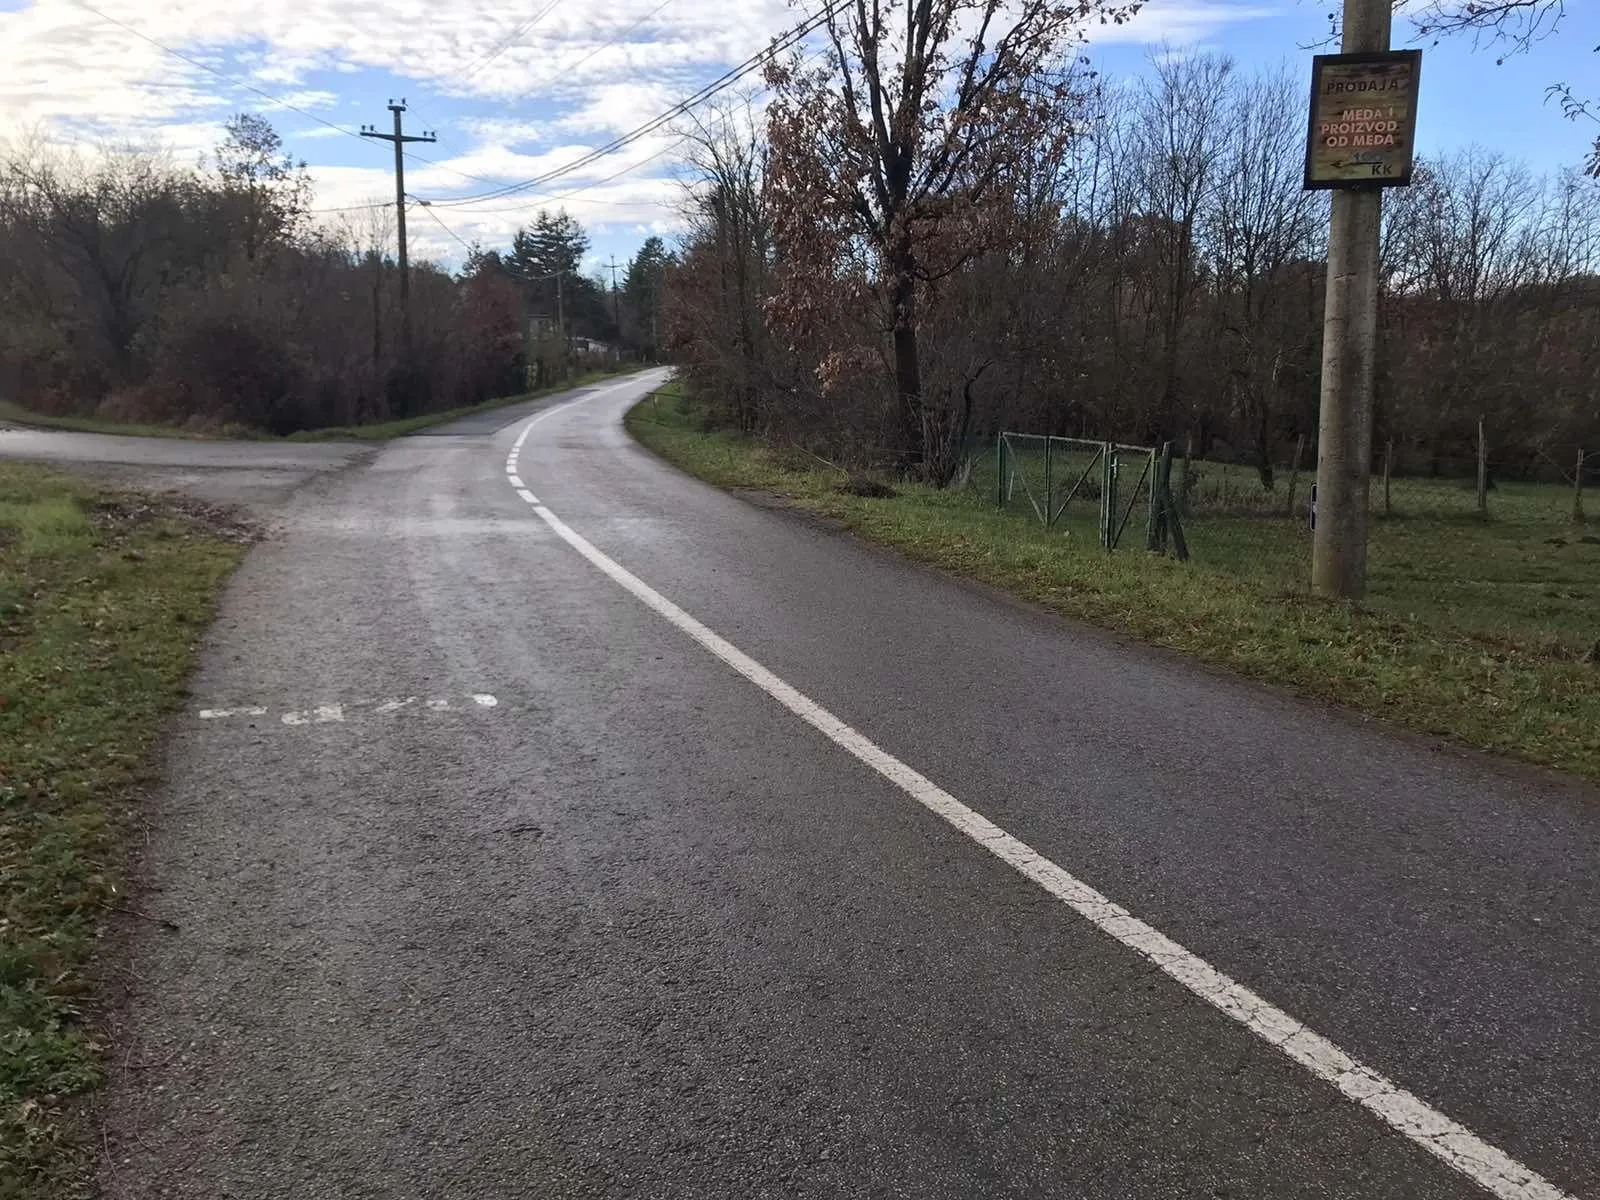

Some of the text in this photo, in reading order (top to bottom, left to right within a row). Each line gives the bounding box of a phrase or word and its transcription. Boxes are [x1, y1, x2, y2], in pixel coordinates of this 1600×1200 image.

[1326, 80, 1399, 93] PRODAJA
[1342, 109, 1382, 121] MEDA
[1321, 121, 1397, 135] PROIZVOD
[1326, 134, 1394, 147] OD MEDA
